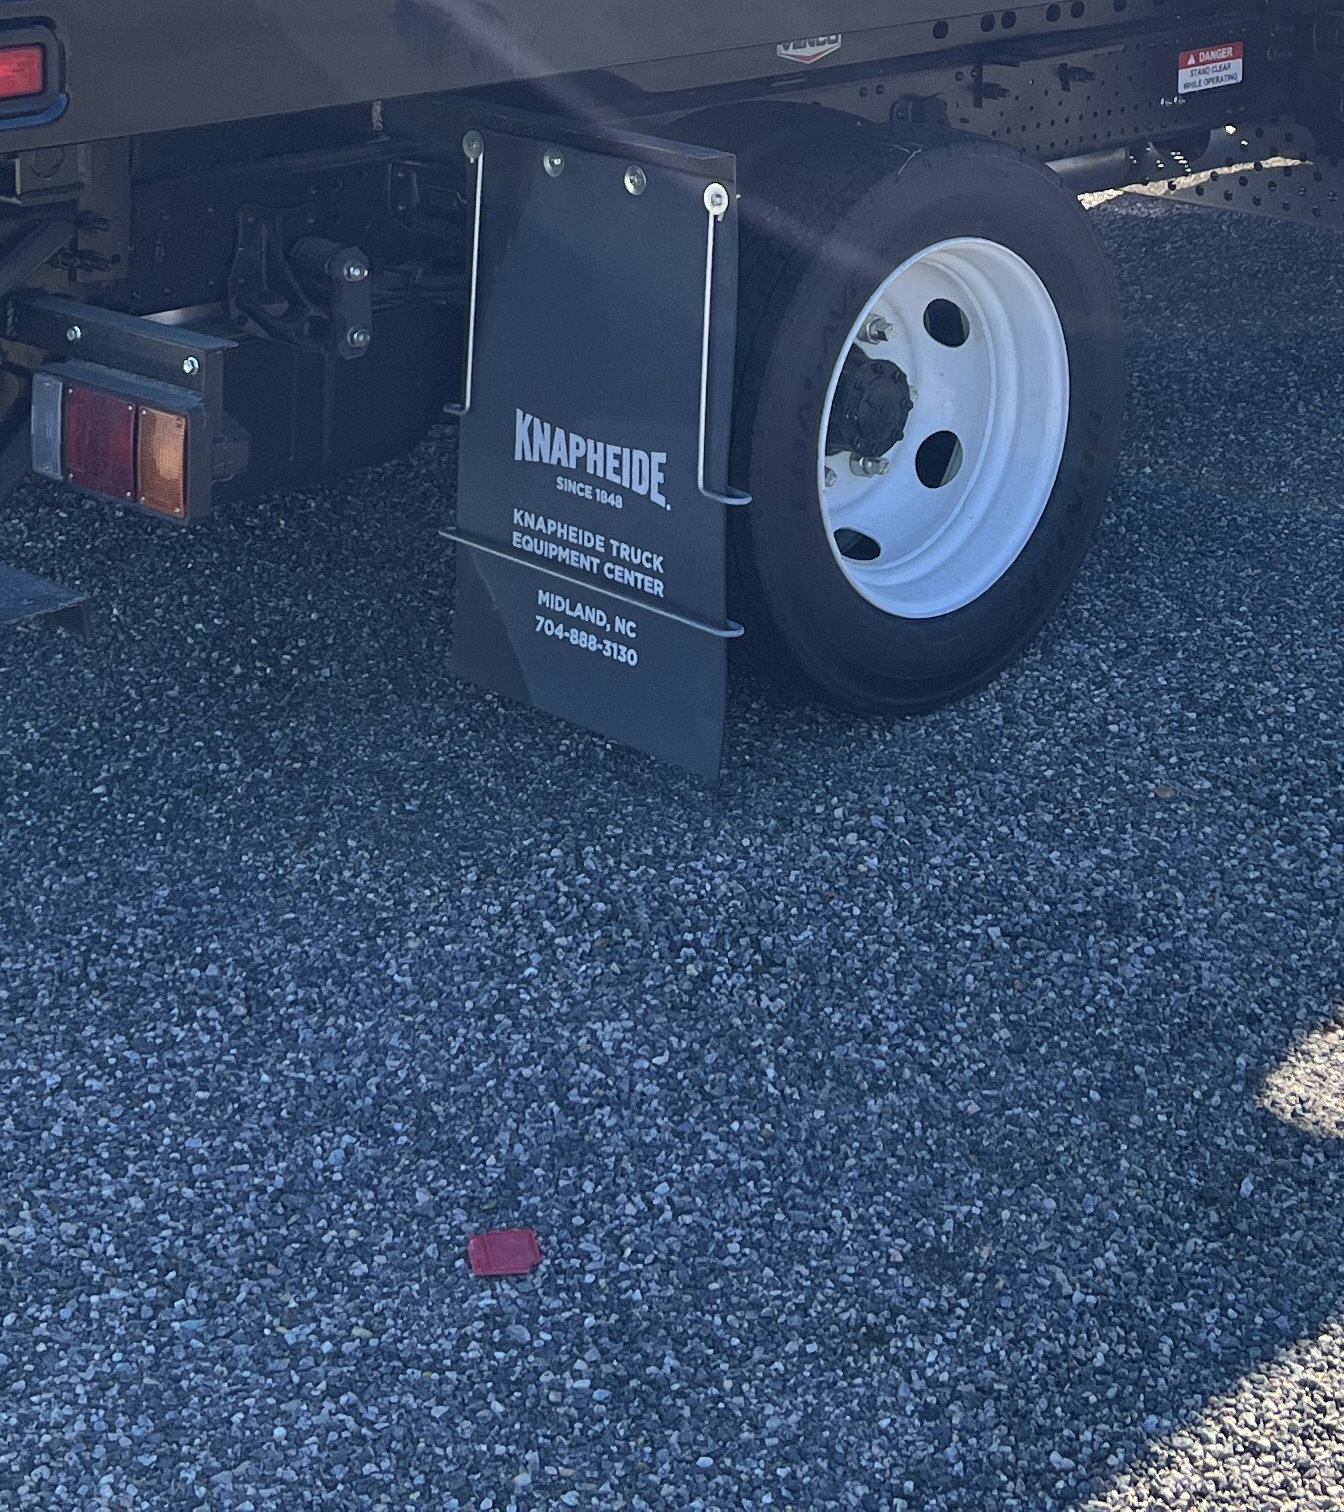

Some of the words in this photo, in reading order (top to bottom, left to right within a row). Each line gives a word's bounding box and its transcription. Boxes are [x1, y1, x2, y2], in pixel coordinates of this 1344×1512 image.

[1190, 66, 1211, 78] STAND
[1211, 62, 1232, 74] CLEAR
[1199, 47, 1233, 63] DANGER
[1203, 72, 1238, 86] OPERATING
[556, 476, 593, 500] SINCE
[595, 488, 624, 509] 1848
[513, 507, 606, 553] KNAPHEIDE
[609, 538, 665, 574] TRUCK
[512, 531, 600, 574] EQUIPMENT
[603, 562, 665, 598] CENTER
[538, 589, 611, 632] MIDLAND,
[614, 615, 637, 639] NC
[535, 614, 638, 667] 704-888-3130
